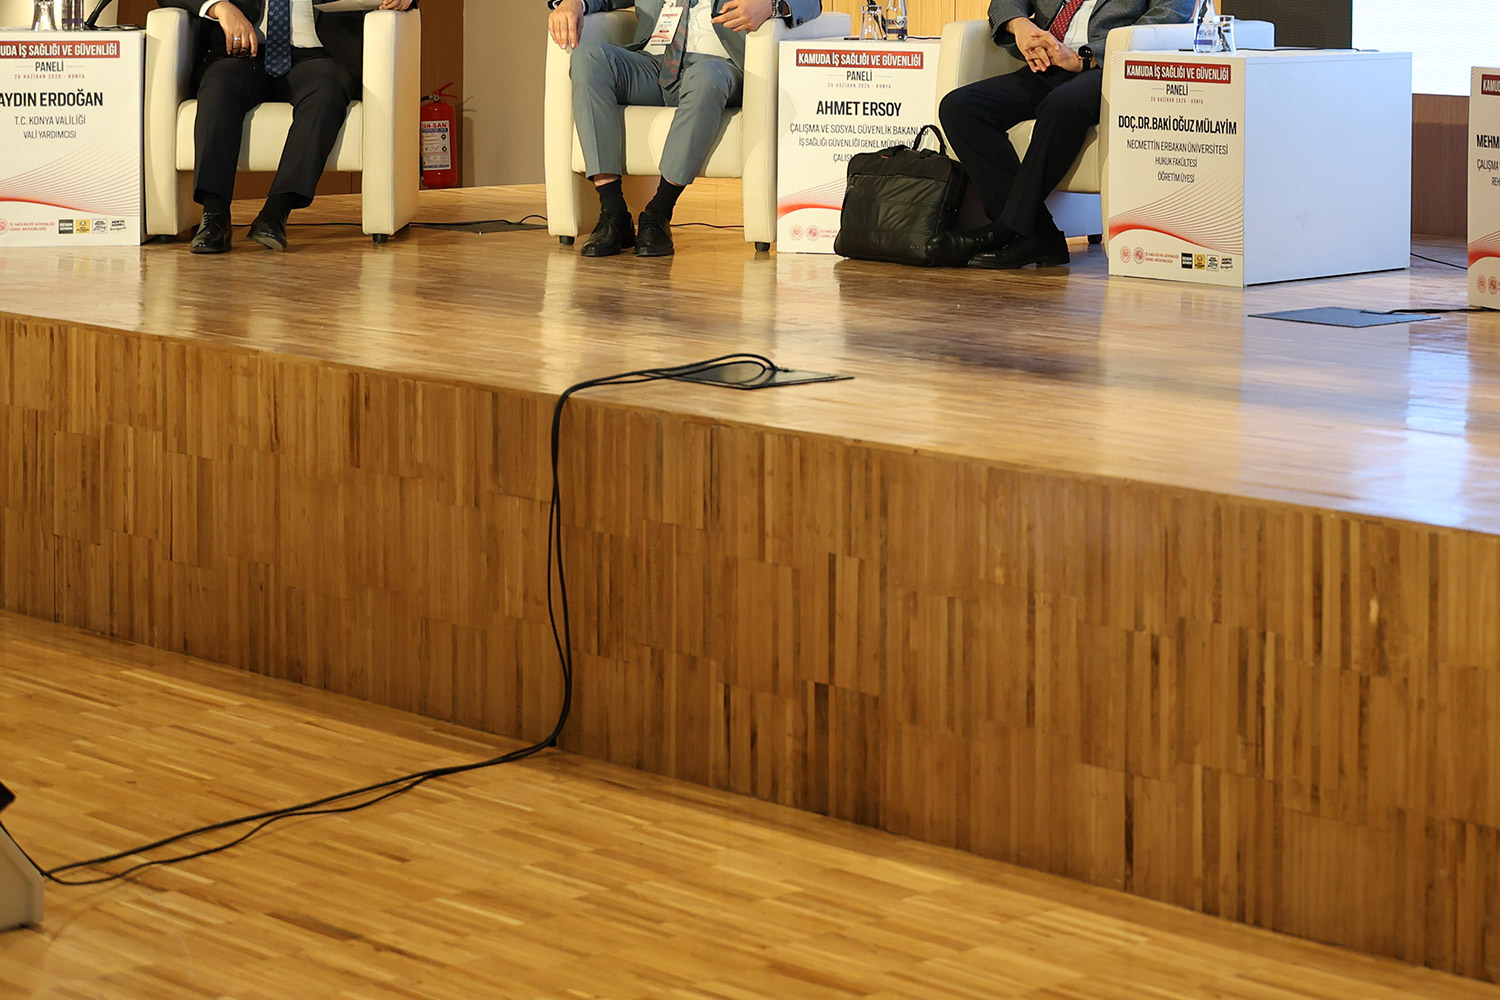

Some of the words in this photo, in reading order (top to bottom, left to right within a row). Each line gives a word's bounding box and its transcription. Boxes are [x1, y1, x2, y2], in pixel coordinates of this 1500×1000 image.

[0, 45, 17, 56] UDA
[19, 43, 27, 58] İŞ
[29, 43, 60, 56] SAĞLIĞI
[62, 45, 72, 56] VE
[75, 43, 117, 56] GÜVENLİĞİ
[35, 60, 64, 72] PANELİ
[799, 53, 830, 65] KAMUDA
[832, 53, 839, 66] İŞ
[841, 53, 869, 65] SAĞLIĞI
[871, 55, 880, 65] VE
[883, 54, 921, 66] GÜVENLİĞİ
[847, 70, 872, 81] PANELİ
[1127, 65, 1153, 77] KAMUDA
[1154, 64, 1160, 79] İŞ
[1162, 66, 1185, 78] SAĞLIĞI
[1187, 68, 1195, 79] VE
[1196, 67, 1228, 81] GÜVENLİĞİ
[1166, 84, 1188, 96] PANELİ
[0, 92, 36, 107] AYDIN
[40, 89, 103, 106] ERDOĞAN
[816, 101, 860, 115] AHMET
[863, 102, 901, 116] ERSOY
[15, 117, 27, 125] T.C.
[29, 116, 53, 125] KONYA
[55, 114, 86, 125] VALİLİĞİ
[1173, 116, 1194, 132] OĞUZ
[1196, 119, 1237, 134] MÜLAYİM
[24, 130, 37, 139] VALİ
[790, 123, 820, 134] ÇALIŞMA
[821, 124, 829, 133] VE
[831, 124, 856, 134] SOSYAL
[857, 124, 891, 135] GÜVENLİK
[1127, 139, 1160, 150] NECMETTİN
[1161, 143, 1187, 152] ERBAKAN
[1188, 142, 1228, 155] ÜNİVERSİTESİ
